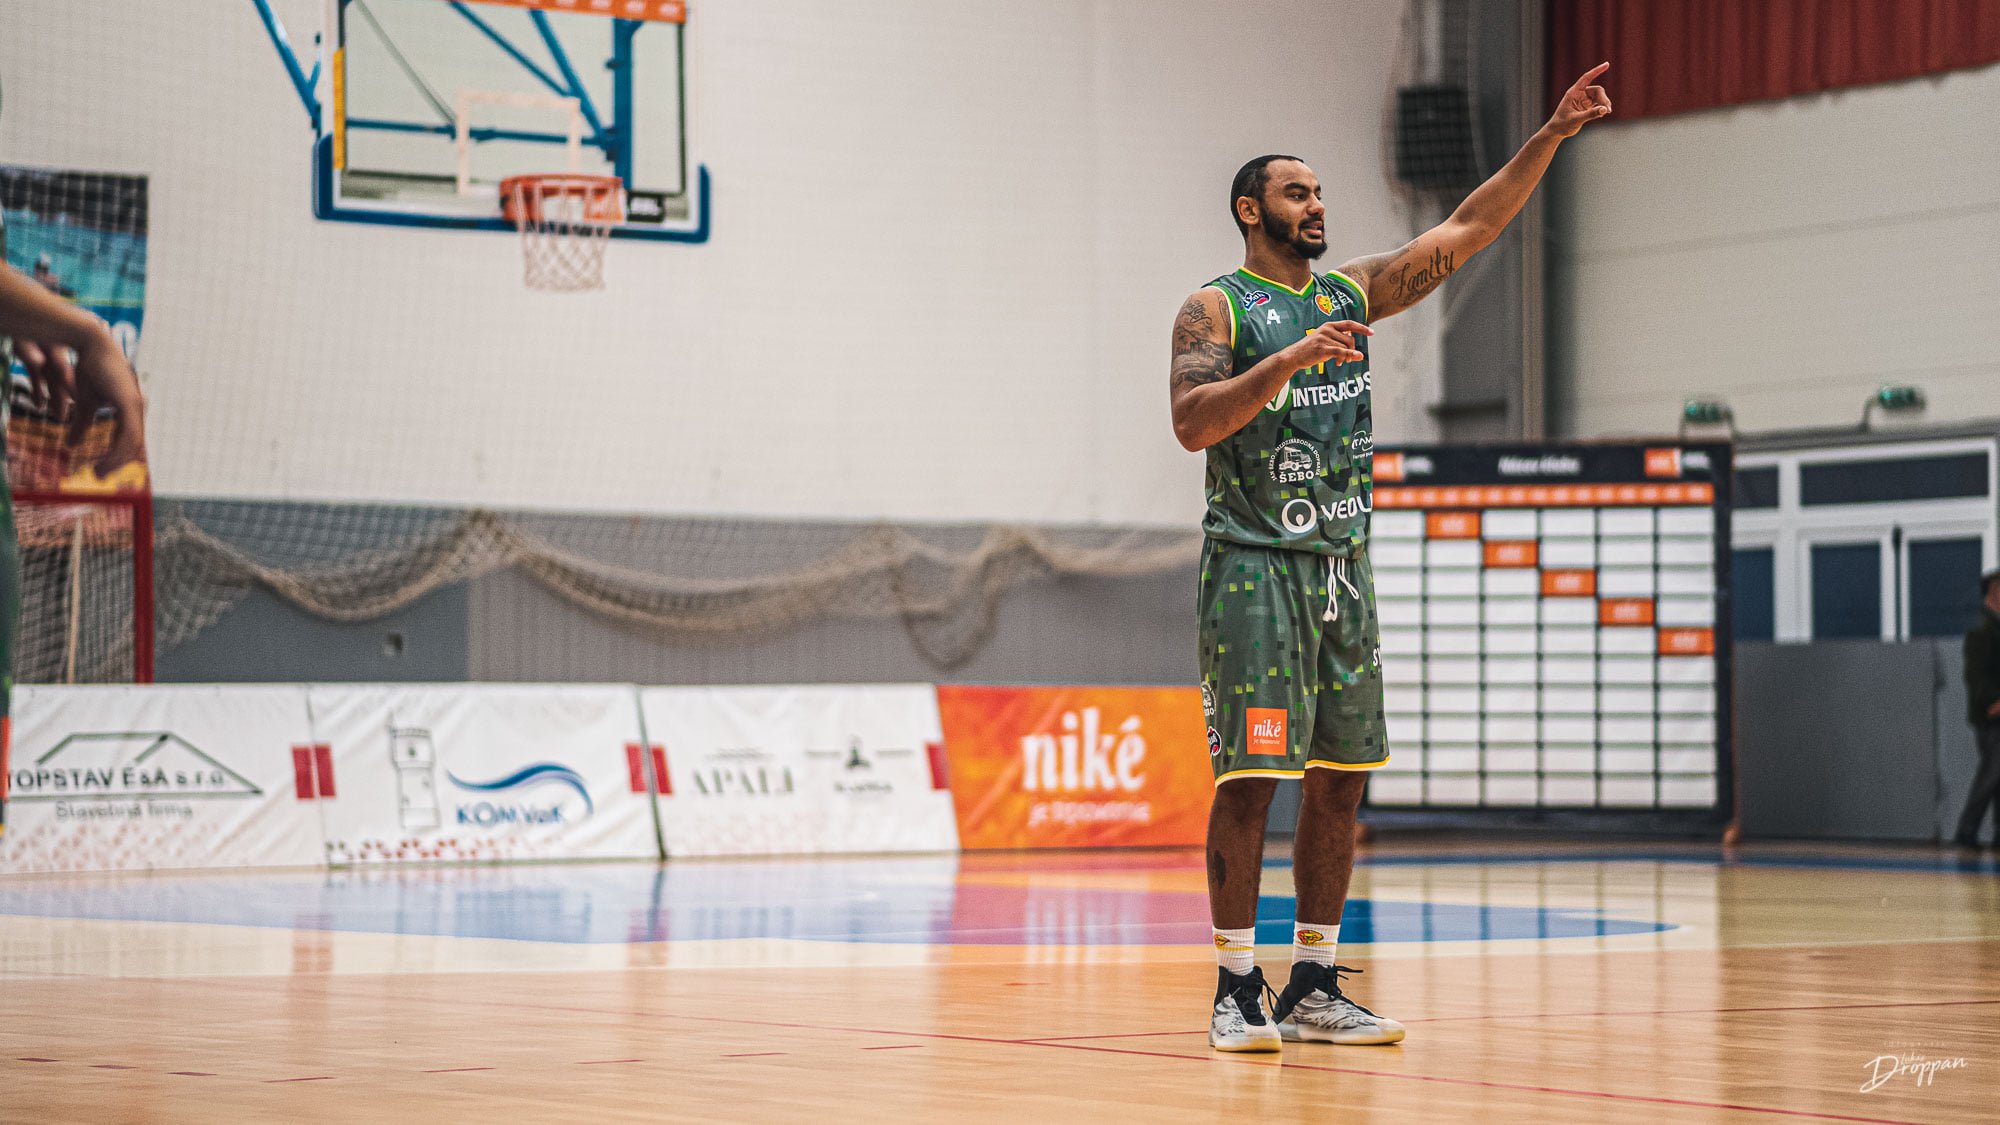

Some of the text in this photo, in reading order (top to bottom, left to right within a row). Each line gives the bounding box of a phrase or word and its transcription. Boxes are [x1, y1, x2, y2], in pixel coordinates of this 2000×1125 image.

[1389, 246, 1456, 301] Family
[1279, 470, 1315, 484] ŠEBO
[1253, 718, 1282, 738] niké
[1021, 706, 1146, 792] niké
